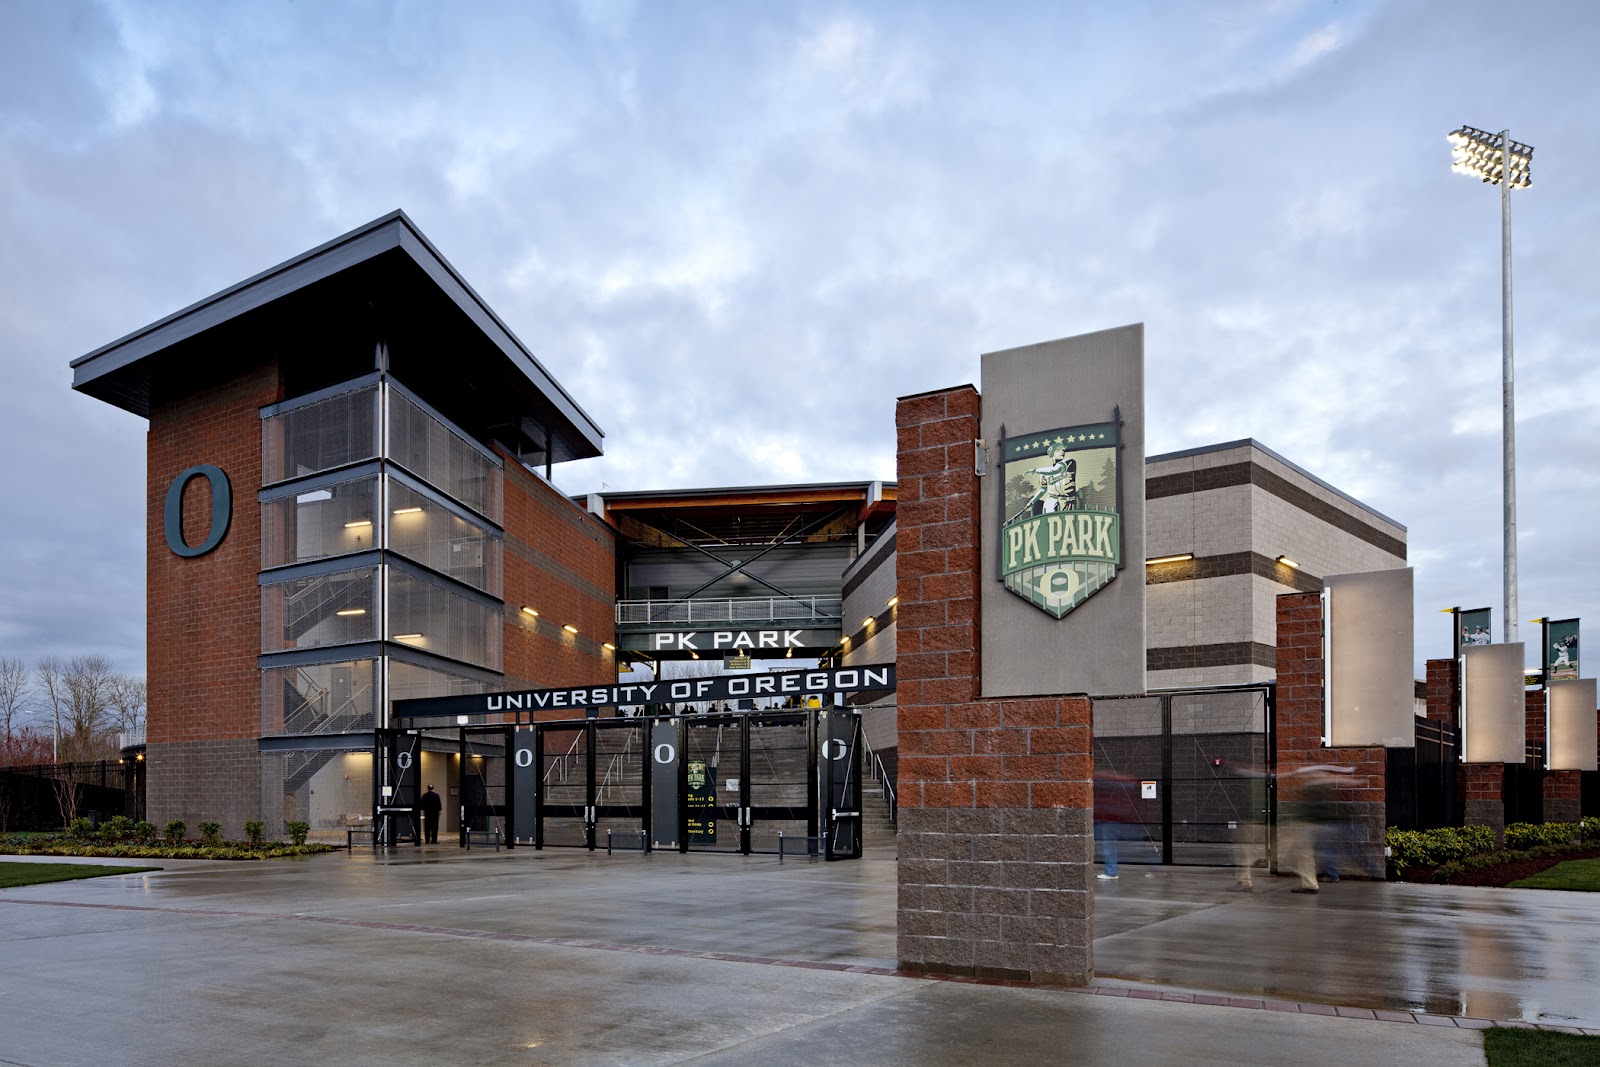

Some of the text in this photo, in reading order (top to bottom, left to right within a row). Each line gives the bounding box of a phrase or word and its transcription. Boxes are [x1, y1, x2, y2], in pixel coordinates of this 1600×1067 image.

[163, 463, 232, 558] O
[1008, 514, 1114, 568] PK PARK
[655, 630, 805, 650] PK PARK
[487, 668, 888, 710] UNIVERSITY OF OREGON
[515, 748, 533, 767] O
[654, 744, 675, 764] O
